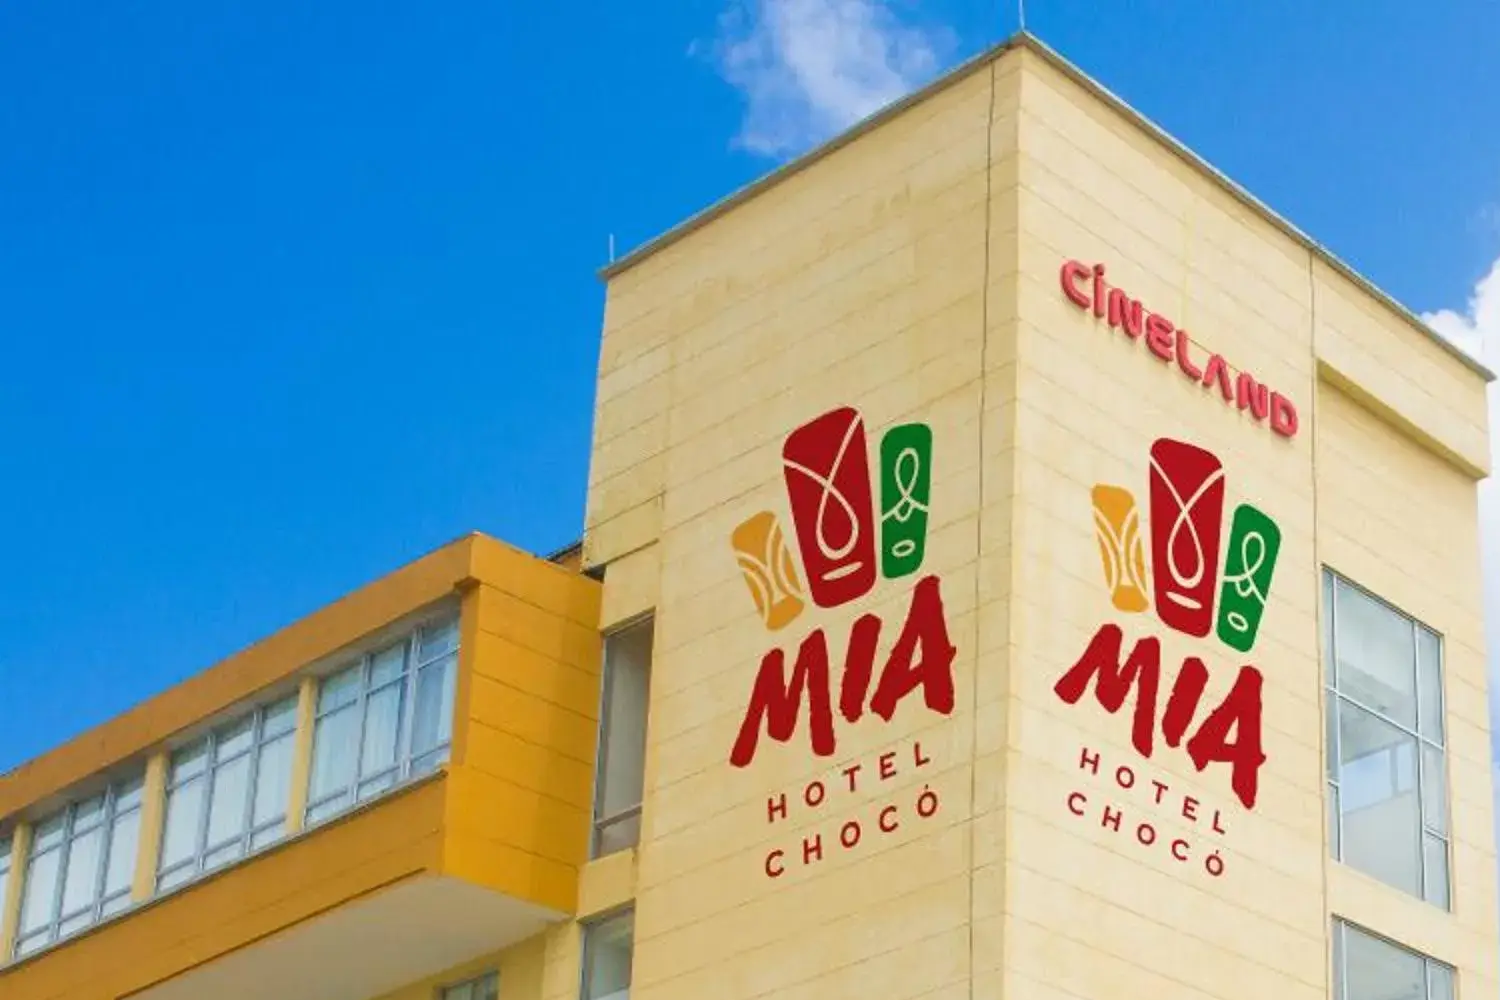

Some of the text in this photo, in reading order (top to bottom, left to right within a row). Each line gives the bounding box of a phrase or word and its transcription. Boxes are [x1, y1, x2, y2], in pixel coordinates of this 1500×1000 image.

[729, 575, 957, 768] MIA
[1054, 624, 1266, 810] MIA
[766, 741, 932, 823] HOTEL
[1079, 747, 1226, 835] HOTEL
[764, 783, 940, 879] CHOCÓ
[1066, 791, 1226, 878] CHOCÓ
